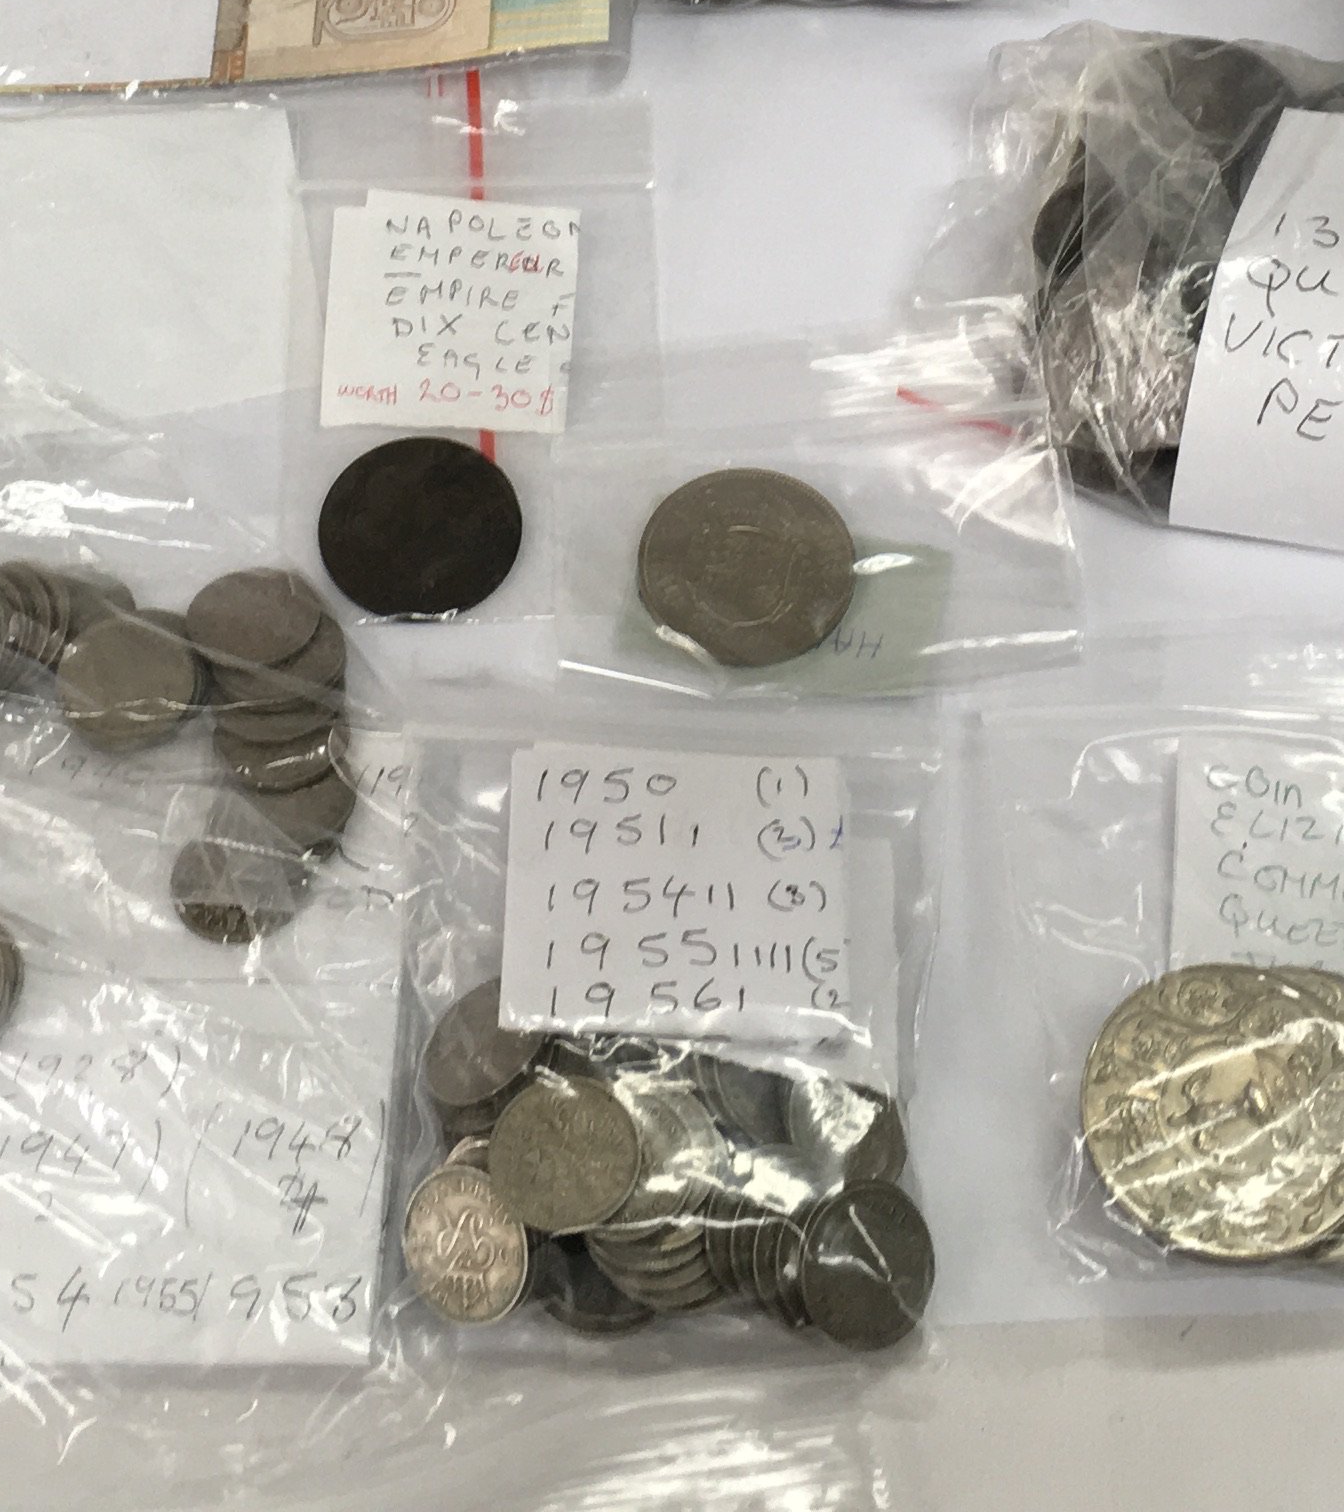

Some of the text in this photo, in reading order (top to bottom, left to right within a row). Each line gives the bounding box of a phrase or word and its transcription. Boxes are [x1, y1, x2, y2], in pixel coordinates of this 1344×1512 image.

[385, 278, 521, 312] EMPIRE
[391, 314, 464, 339] DIX
[416, 342, 537, 381] EAGLE
[537, 766, 678, 805] 1950
